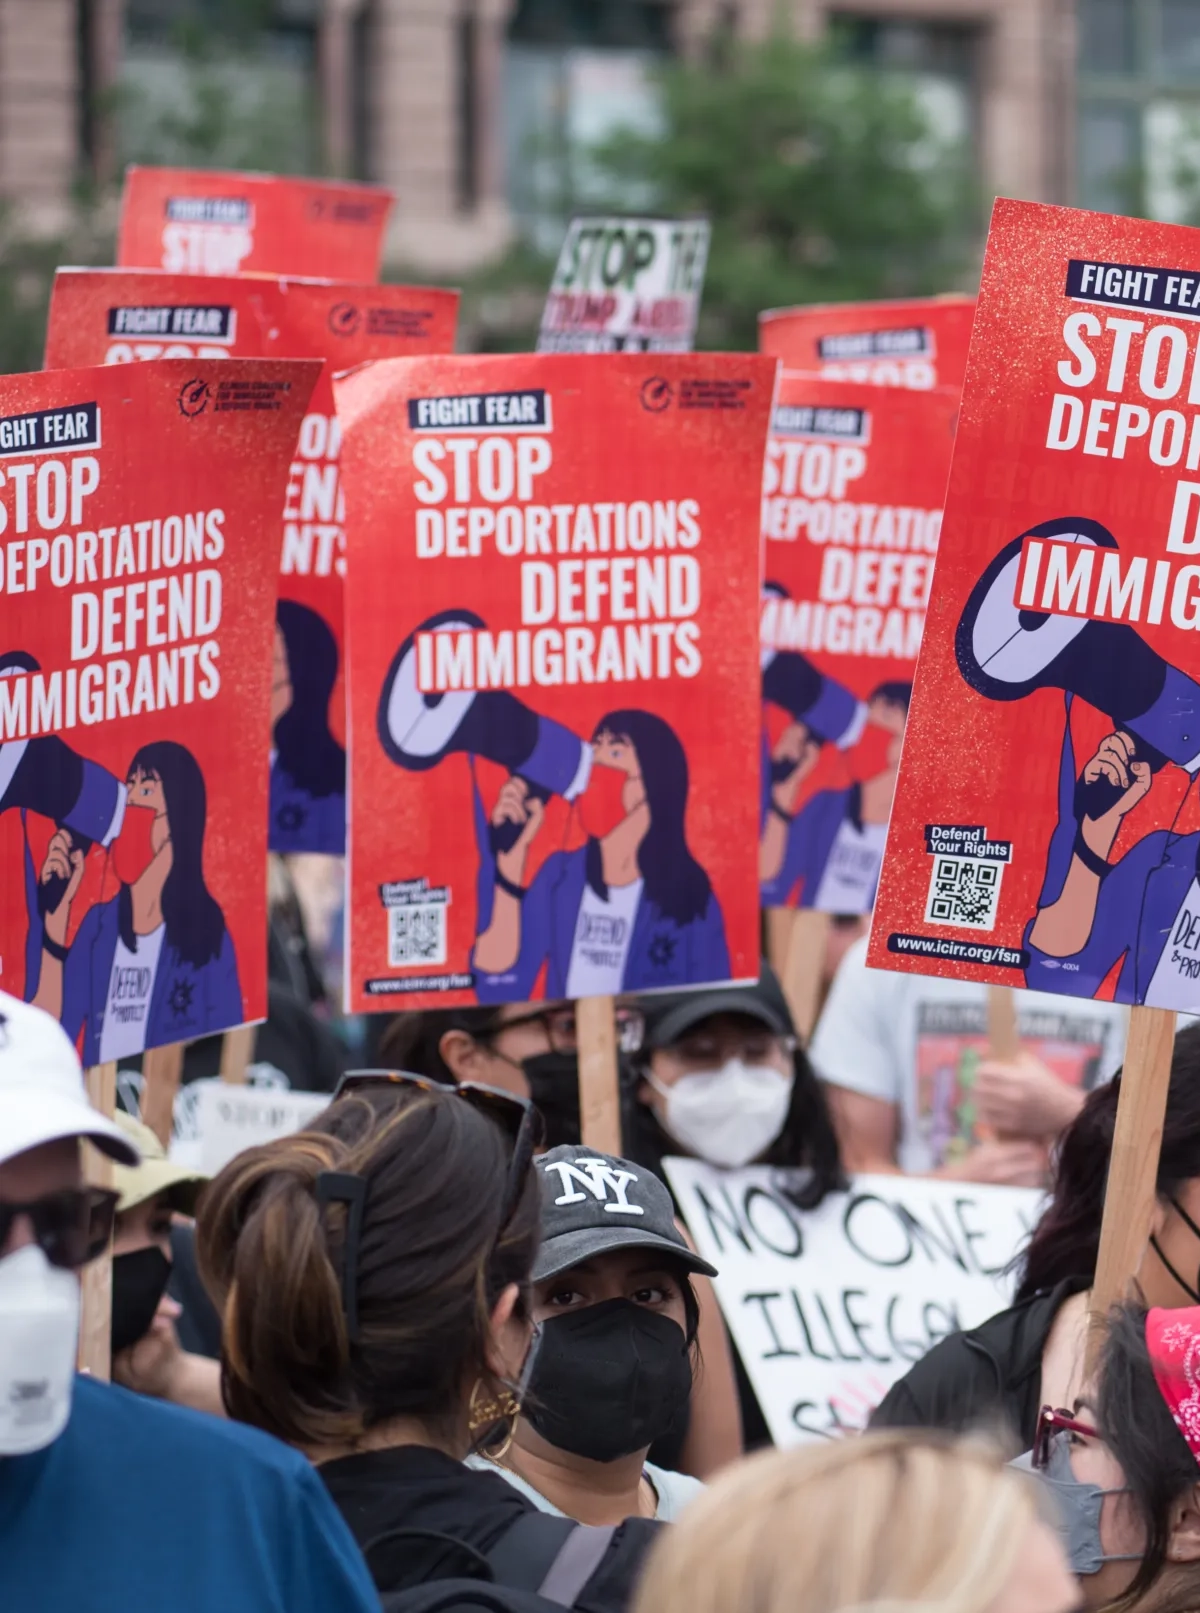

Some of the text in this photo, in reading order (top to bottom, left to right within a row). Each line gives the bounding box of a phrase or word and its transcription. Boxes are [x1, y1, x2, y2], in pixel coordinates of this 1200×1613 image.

[563, 229, 656, 291] STOP
[1080, 264, 1160, 303] FIGHT
[172, 308, 223, 334] FEAR
[0, 411, 89, 449] GHT FEAR
[417, 396, 537, 426] FIGHT FEAR
[412, 437, 552, 504] STOP
[0, 508, 225, 596] EPORTATIONS
[415, 499, 701, 559] DEPORTATIONS
[761, 497, 944, 553] EPORTATIO
[520, 555, 701, 626] DEFEND
[819, 546, 936, 609] DEFE
[71, 568, 223, 661] DEFEND
[760, 598, 928, 660] MIGRAN
[417, 623, 702, 692] IMMIGRANTS
[0, 640, 220, 741] MMIGRANTS
[930, 839, 1007, 857] Your Rights
[931, 826, 980, 841] Defend
[897, 937, 1021, 964] www.icirr.org/fsn
[1062, 963, 1080, 972] 4004
[1171, 950, 1181, 962] &
[110, 965, 152, 1000] DEFEND
[544, 1157, 644, 1216] NY
[693, 1181, 1008, 1276] NO ONE
[743, 1287, 966, 1366] ILLEGA
